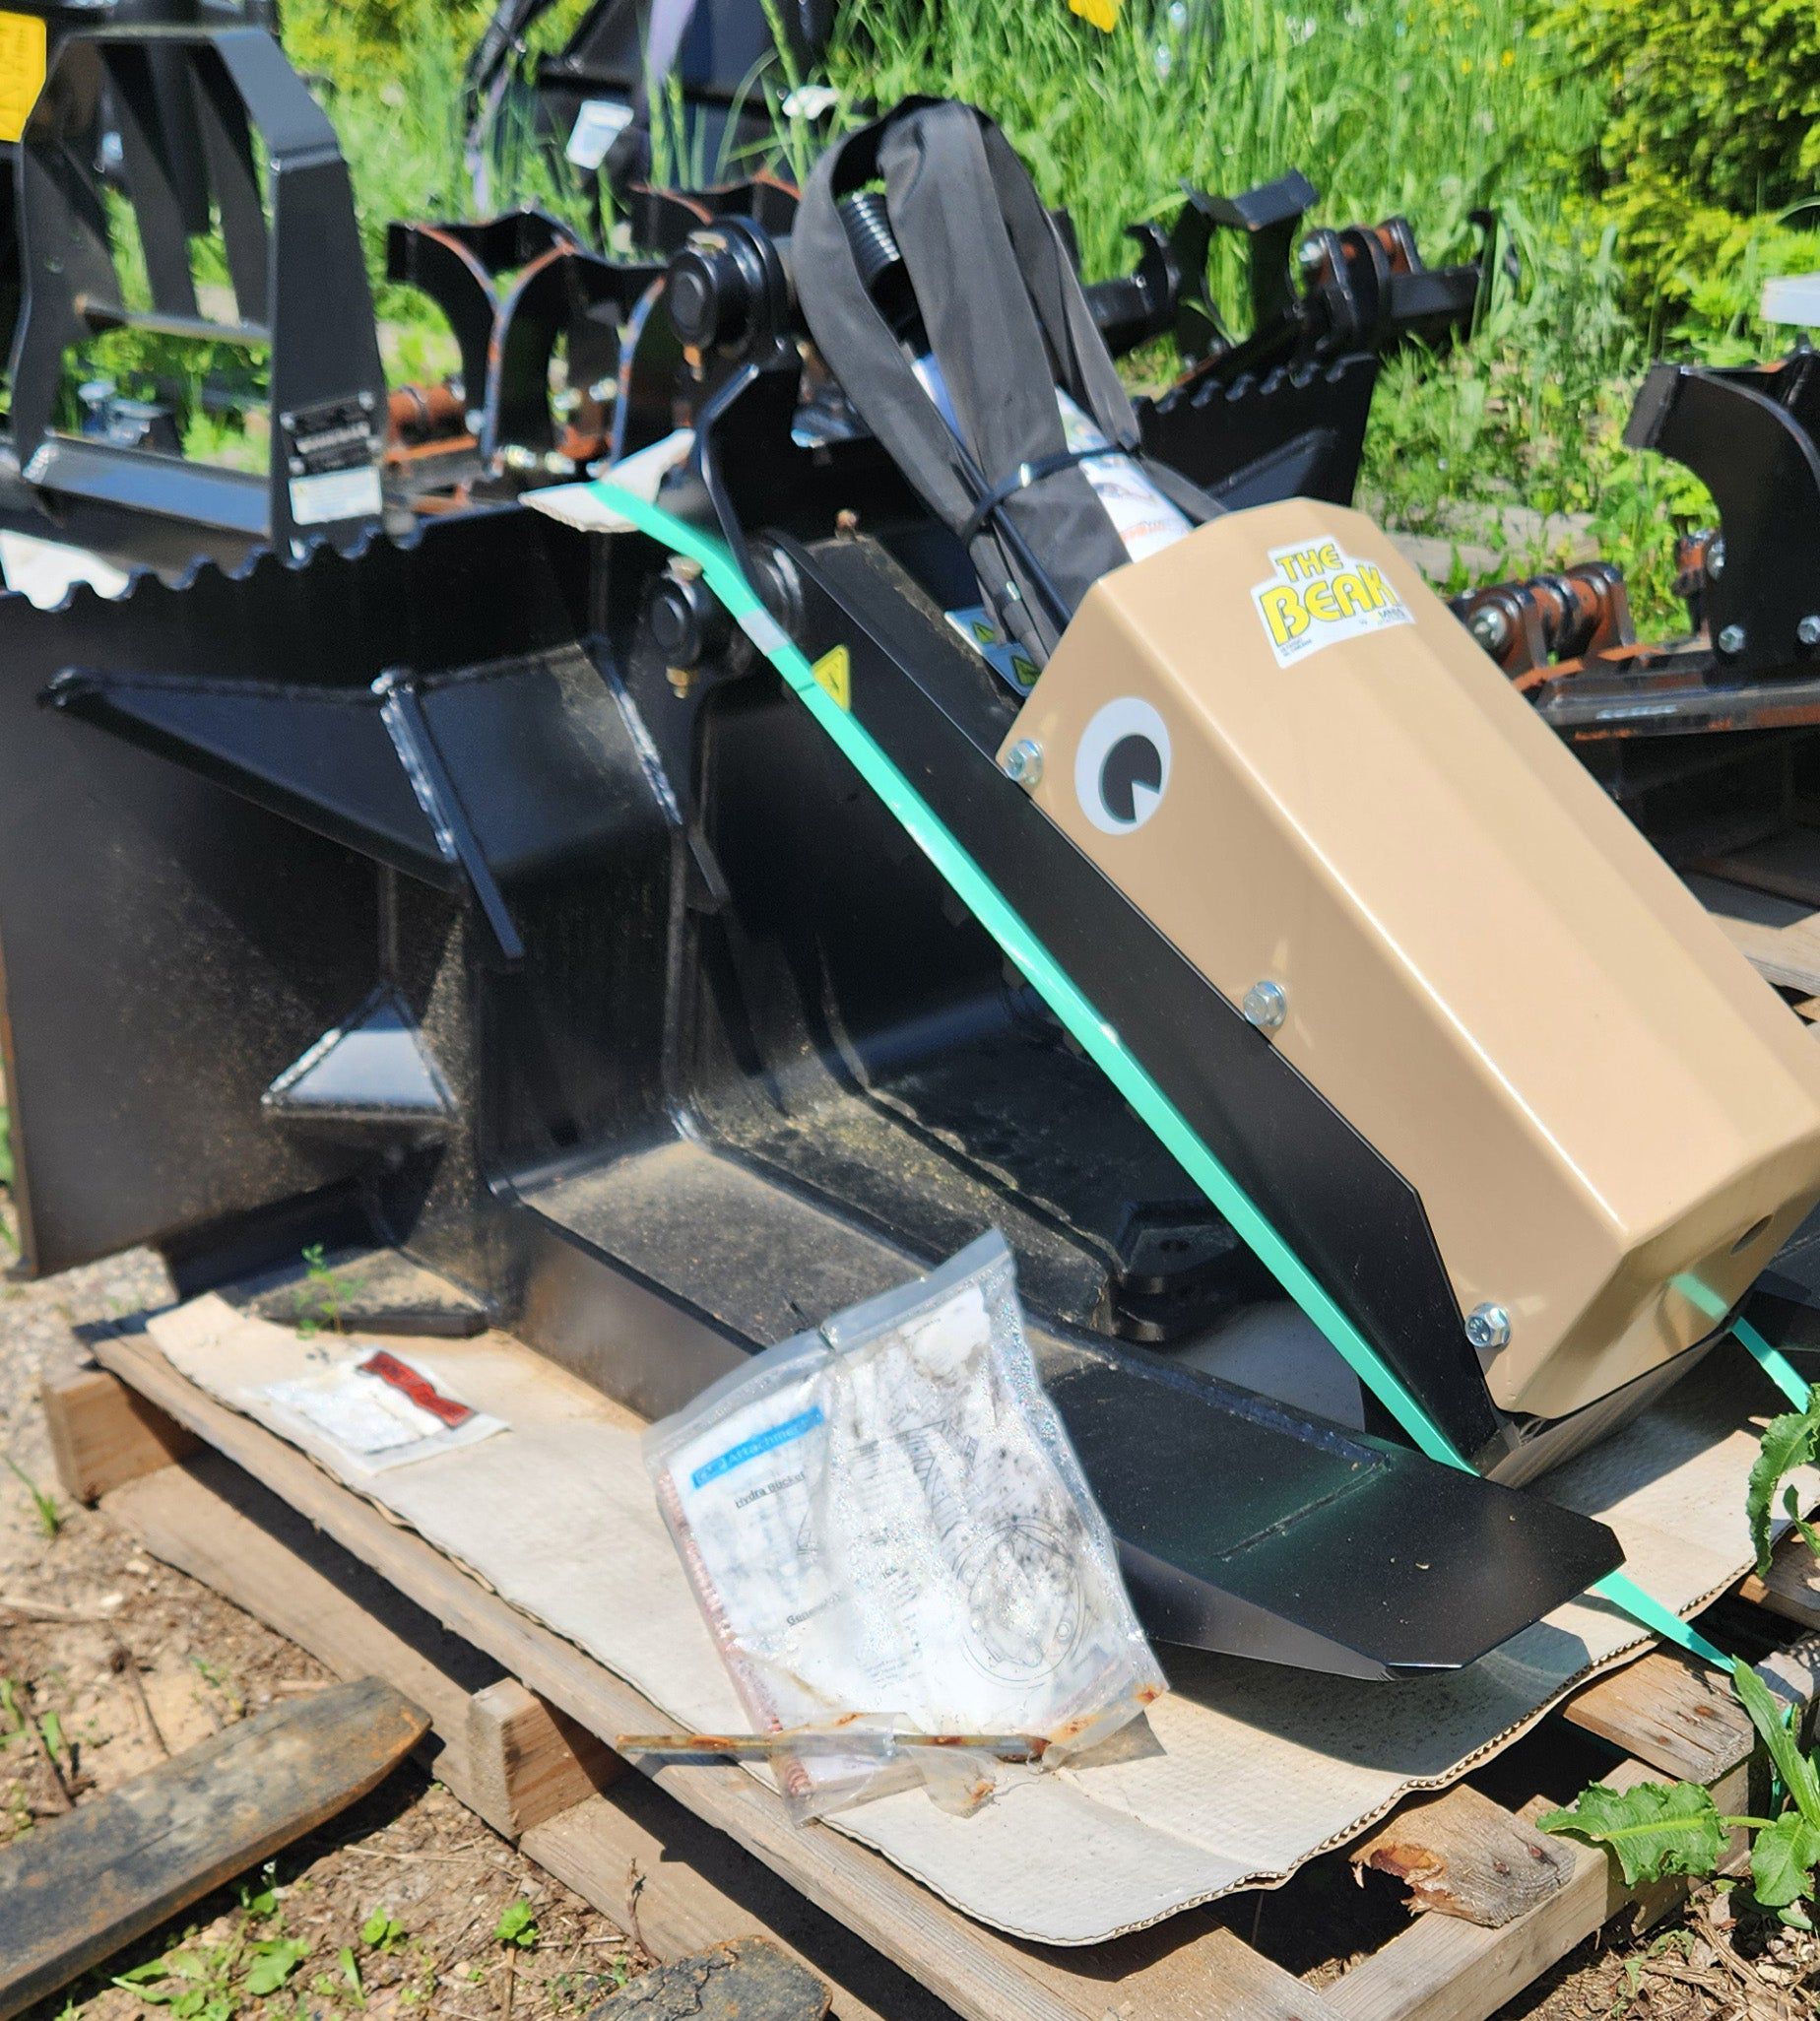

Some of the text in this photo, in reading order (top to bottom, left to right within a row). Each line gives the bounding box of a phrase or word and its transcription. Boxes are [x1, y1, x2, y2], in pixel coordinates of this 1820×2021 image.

[1275, 543, 1343, 583] THE
[1259, 563, 1399, 647] BEAK
[735, 1486, 766, 1509] Hydra
